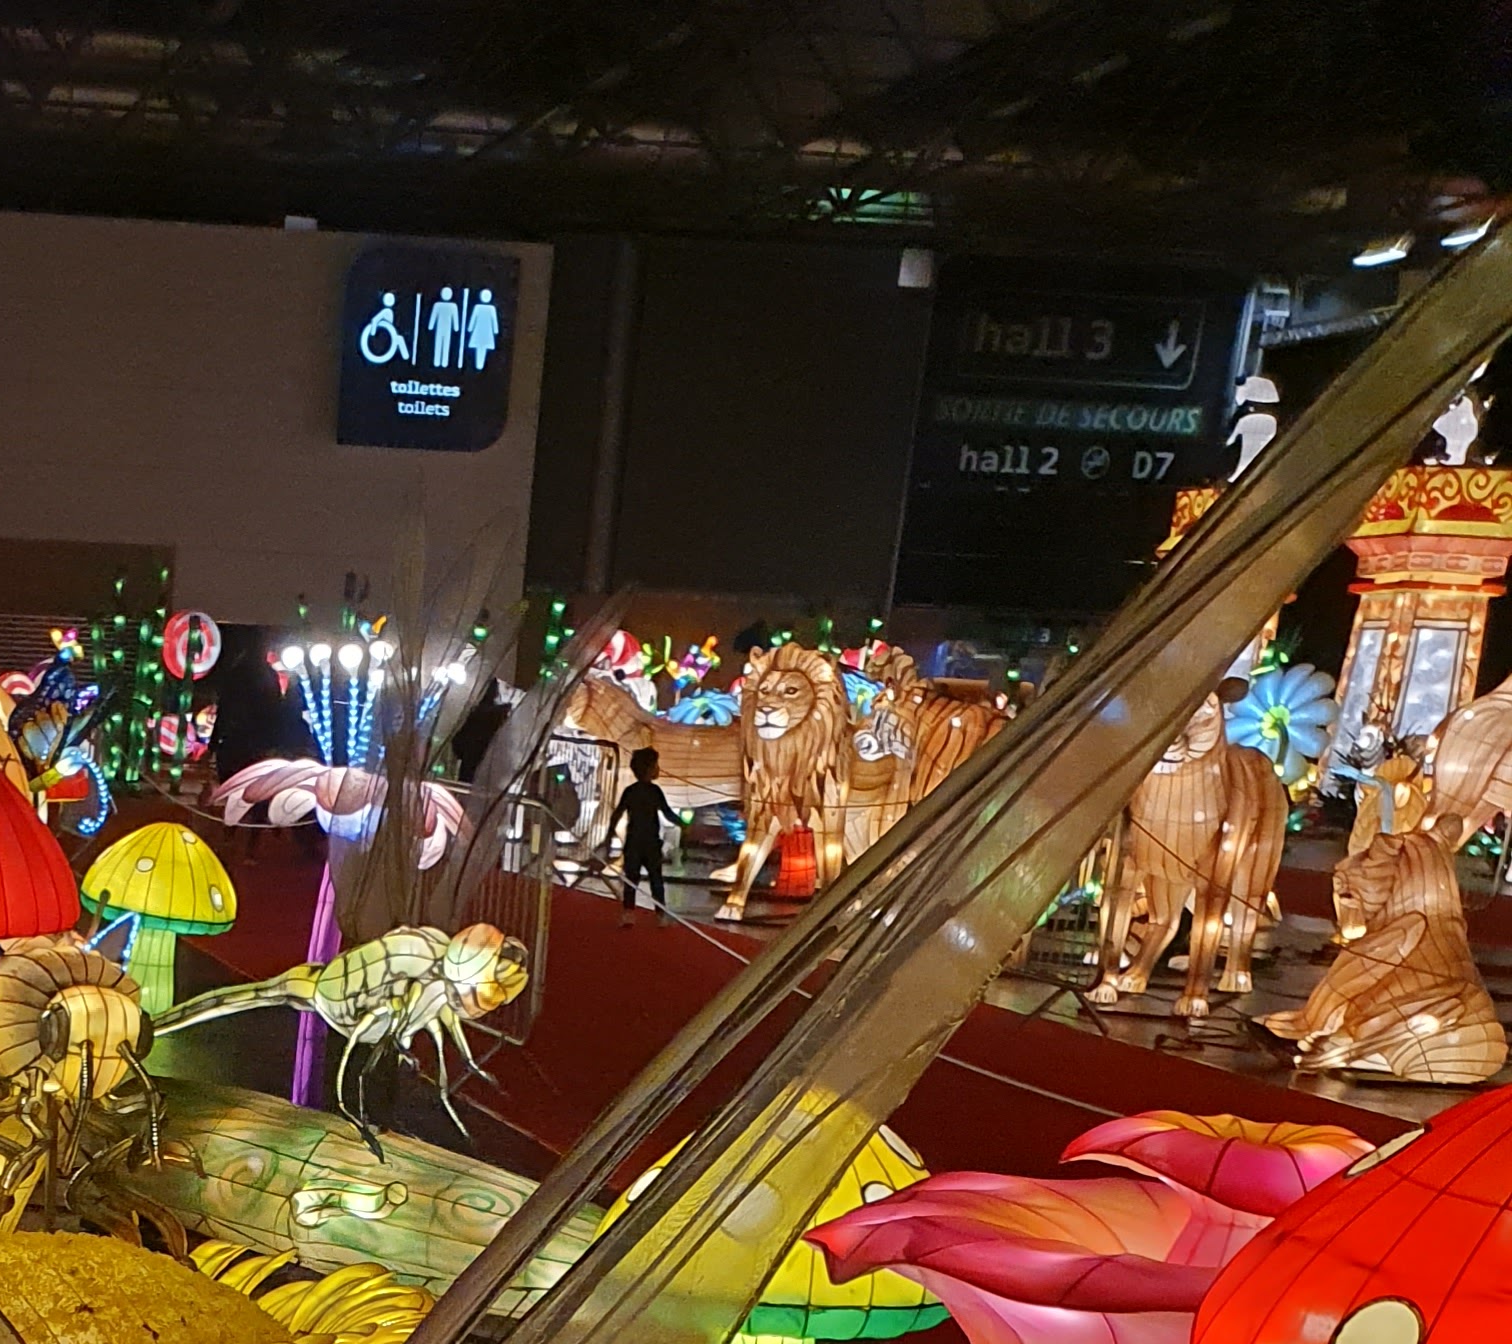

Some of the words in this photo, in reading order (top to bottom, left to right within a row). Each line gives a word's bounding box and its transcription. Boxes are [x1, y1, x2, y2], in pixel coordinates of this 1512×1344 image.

[972, 313, 1073, 358] hall
[1085, 319, 1115, 361] 3
[390, 380, 461, 397] toilettes
[398, 401, 450, 417] toilets
[1035, 402, 1071, 428] DE
[1078, 404, 1203, 434] SECOURS
[958, 443, 1031, 475] hall
[1037, 446, 1060, 476] 2
[1131, 450, 1176, 481] D7
